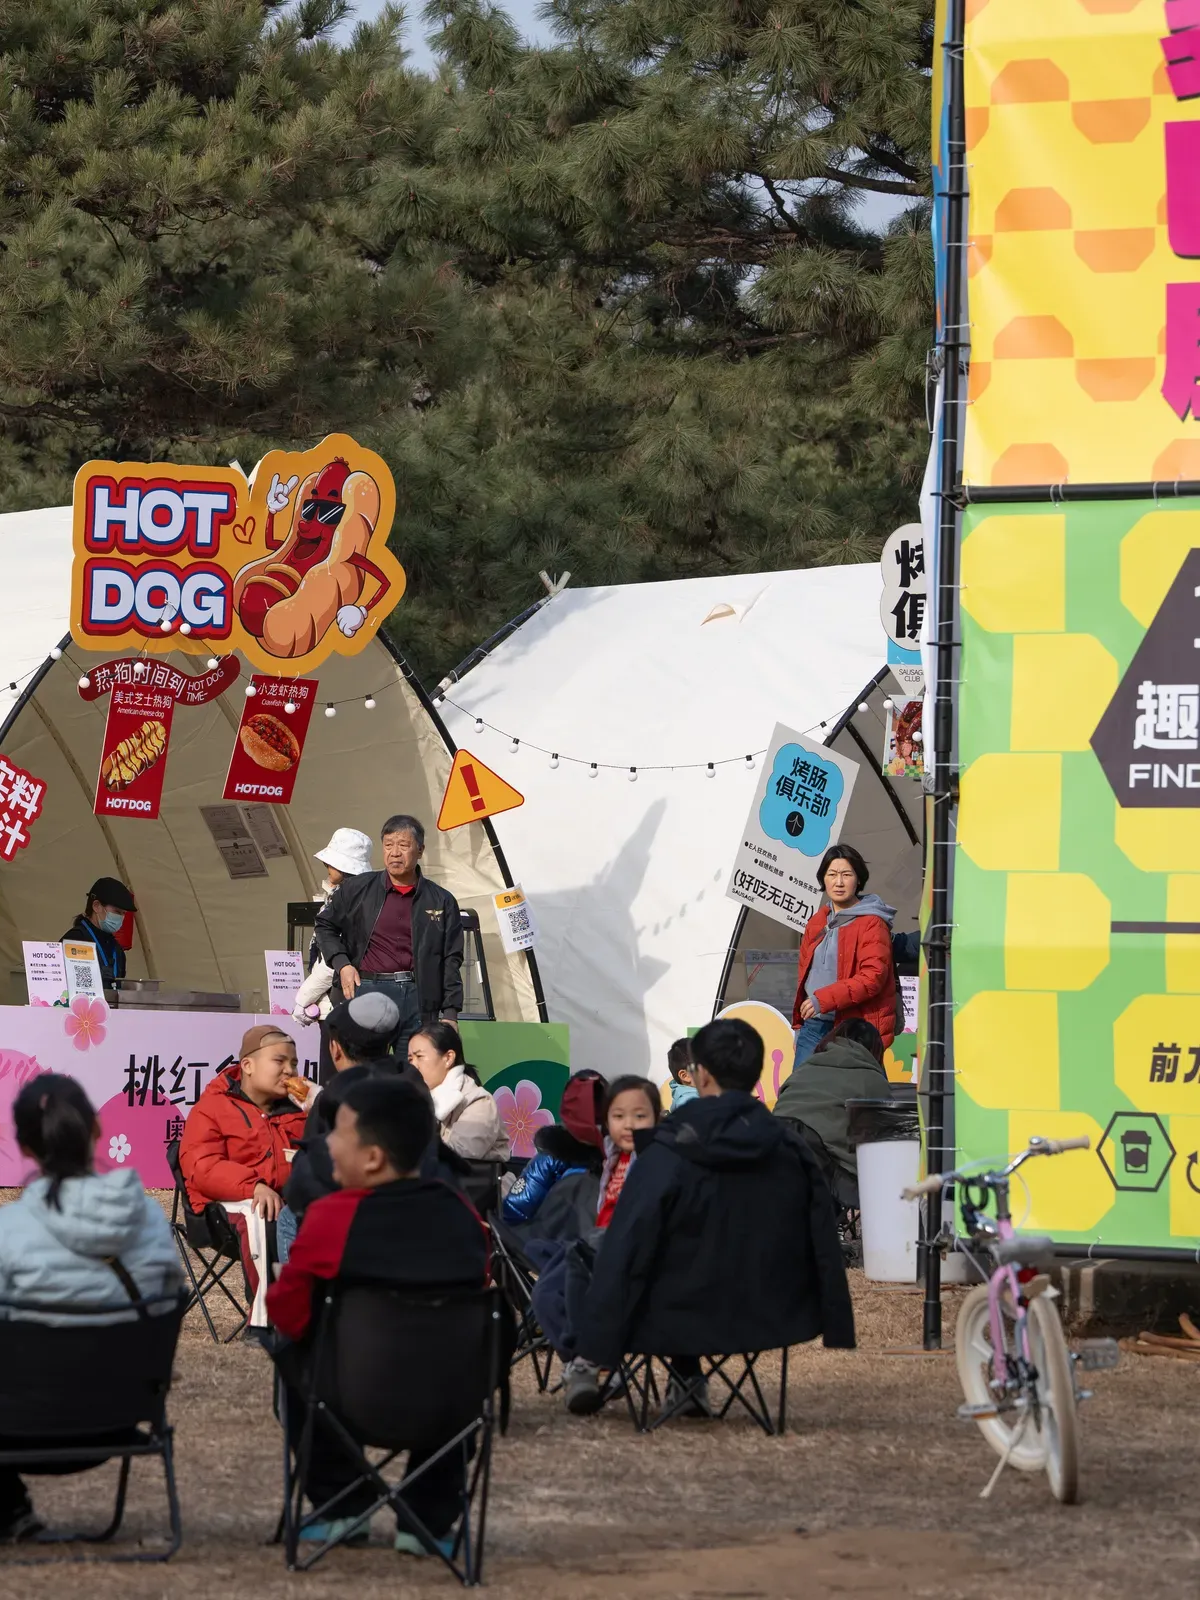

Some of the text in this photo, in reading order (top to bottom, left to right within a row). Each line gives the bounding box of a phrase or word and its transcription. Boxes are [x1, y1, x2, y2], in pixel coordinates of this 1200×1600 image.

[90, 487, 228, 626] HOT DOG
[187, 668, 224, 691] HOT DOG
[899, 668, 924, 676] SAUSAG
[113, 690, 173, 709] 美式芝士热狗
[257, 682, 310, 700] 小龙虾热狗
[117, 706, 140, 716] American
[155, 710, 165, 719] dog
[789, 756, 829, 794] 烤肠
[234, 783, 283, 796] HOT DOG
[775, 774, 831, 818] 俱乐部
[105, 797, 152, 811] HOT DOG
[786, 914, 806, 928] SAUSAG
